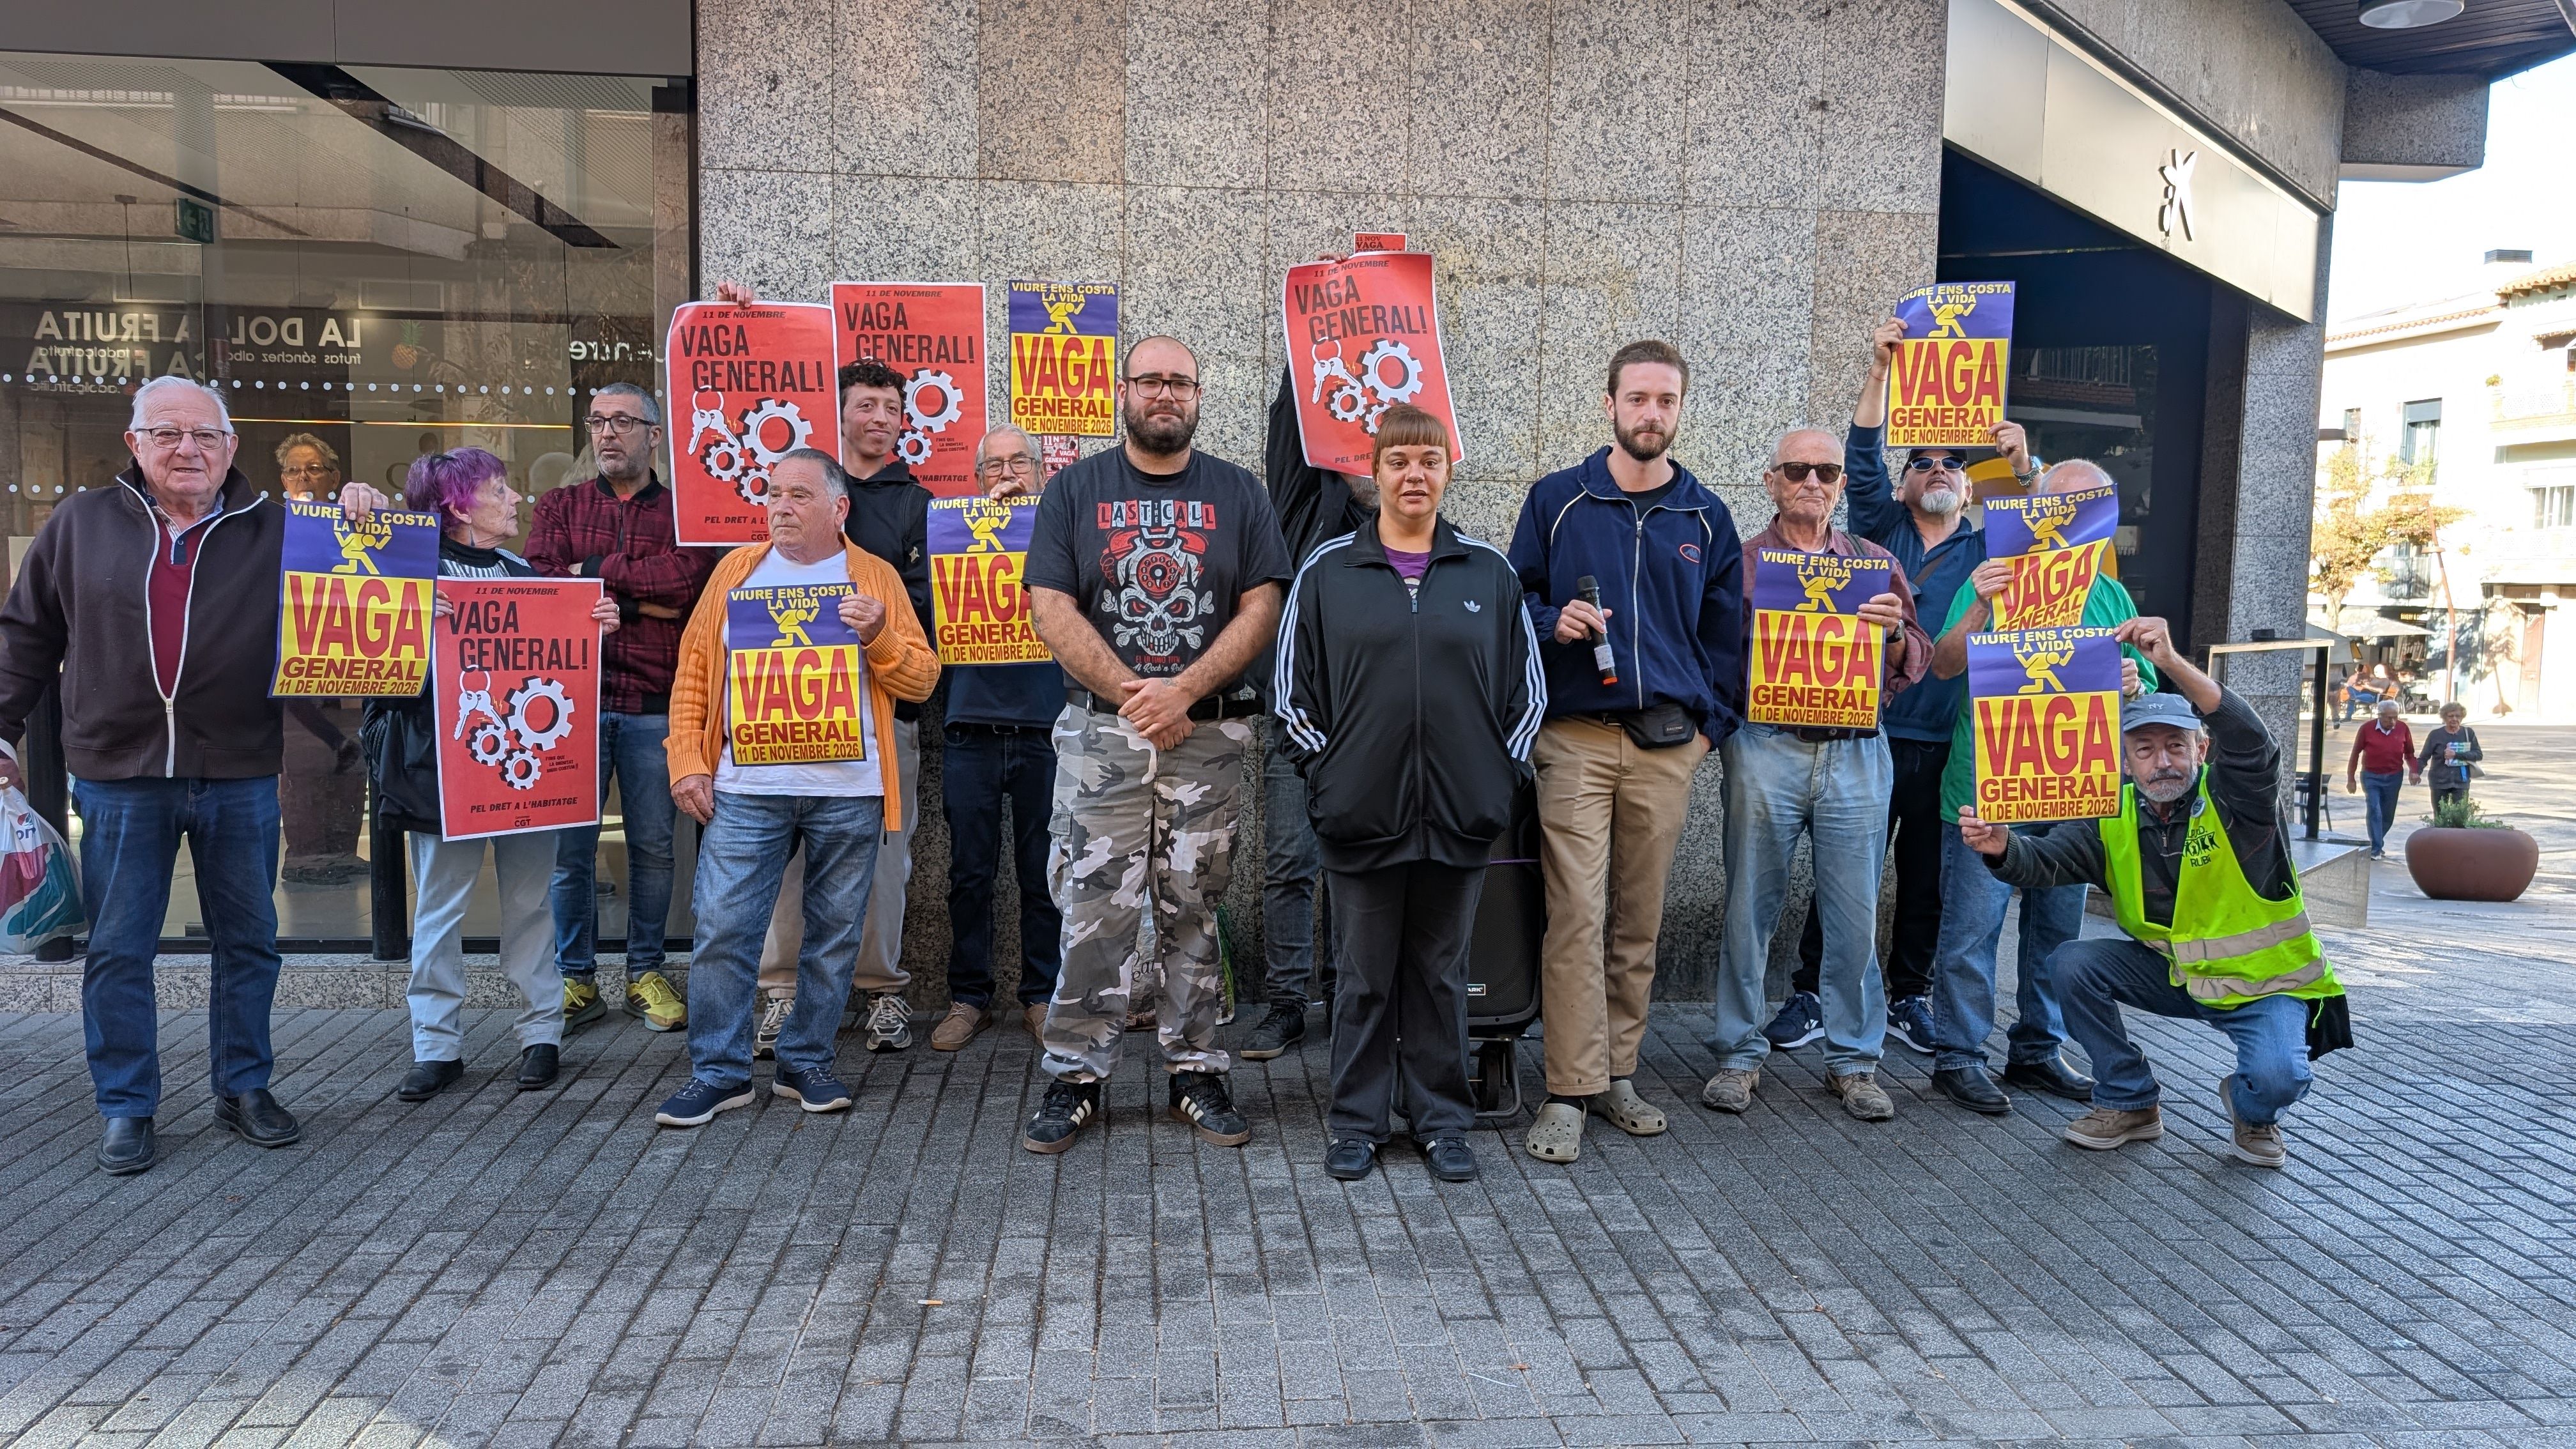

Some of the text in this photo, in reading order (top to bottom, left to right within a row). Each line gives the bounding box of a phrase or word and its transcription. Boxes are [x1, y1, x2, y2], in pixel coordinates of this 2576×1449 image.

[1314, 260, 1390, 277] 11 DE NOVEMBRE
[1012, 282, 1115, 295] VIURE ENS COSTA
[1042, 293, 1085, 303] LA VIDA
[1294, 275, 1360, 315] VAGA
[1900, 284, 2011, 304] VIURE ENS COSTA
[1927, 295, 1977, 304] LA VIDA
[733, 310, 786, 319] NOVEMBRE
[844, 302, 908, 331] VAGA
[1308, 305, 1427, 346] GENERAL!
[680, 324, 750, 358] VAGA
[855, 334, 975, 364] GENERAL!
[692, 360, 825, 394] GENERAL!
[1015, 335, 1112, 399] VAGA
[1896, 341, 2001, 407] VAGA
[1014, 397, 1112, 418] GENERAL
[1014, 418, 1112, 434] 11 DE NOVEMBRE 2026
[1891, 408, 1997, 428] GENERAL
[1890, 431, 1899, 443] 11
[1903, 430, 1915, 443] DE
[1919, 429, 1974, 444] NOVEMBRE
[931, 499, 969, 510] VIURE
[972, 497, 998, 507] ENS
[1986, 487, 2114, 510] VIURE ENS COSTA
[291, 503, 341, 519] VIURE
[381, 514, 436, 527] COSTA
[724, 516, 748, 525] DRET
[963, 507, 1012, 518] LA VIDA
[1100, 503, 1151, 525] LAST
[1164, 503, 1215, 525] CALL
[2021, 504, 2077, 519] LA VIDA
[334, 520, 392, 535] LA VIDA
[1761, 551, 1889, 570] VIURE ENS COSTA
[1797, 565, 1851, 579] LA VIDA
[507, 587, 560, 595] NOVEMBRE
[2000, 543, 2096, 622] VAGA
[731, 585, 854, 601] VIURE ENS COSTA
[767, 597, 820, 610] LA VIDA
[289, 574, 425, 659] VAGA
[448, 601, 519, 634] VAGA
[1970, 628, 2114, 645] VIURE ENS COSTA
[2013, 640, 2074, 653] LA VIDA
[459, 638, 588, 672] GENERAL!
[941, 643, 1049, 662] 11 DE NOVEMBRE 2026
[1759, 613, 1876, 689] VAGA
[282, 657, 421, 681] GENERAL
[279, 681, 419, 694] 11 DE NOVEMBRE 2026
[735, 648, 857, 722] VAGA
[1752, 685, 1874, 712] GENERAL
[1751, 707, 1873, 726] 11 DE NOVEMBRE 2026
[735, 720, 858, 746] GENERAL
[1978, 695, 2116, 777] VAGA
[737, 743, 859, 762] 11 DE NOVEMBRE 2026
[1980, 775, 2116, 803] GENERAL
[470, 797, 578, 813] PEL DRET A L'HABITATGE
[1981, 799, 2115, 822] 11 DE NOVEMBRE 2026
